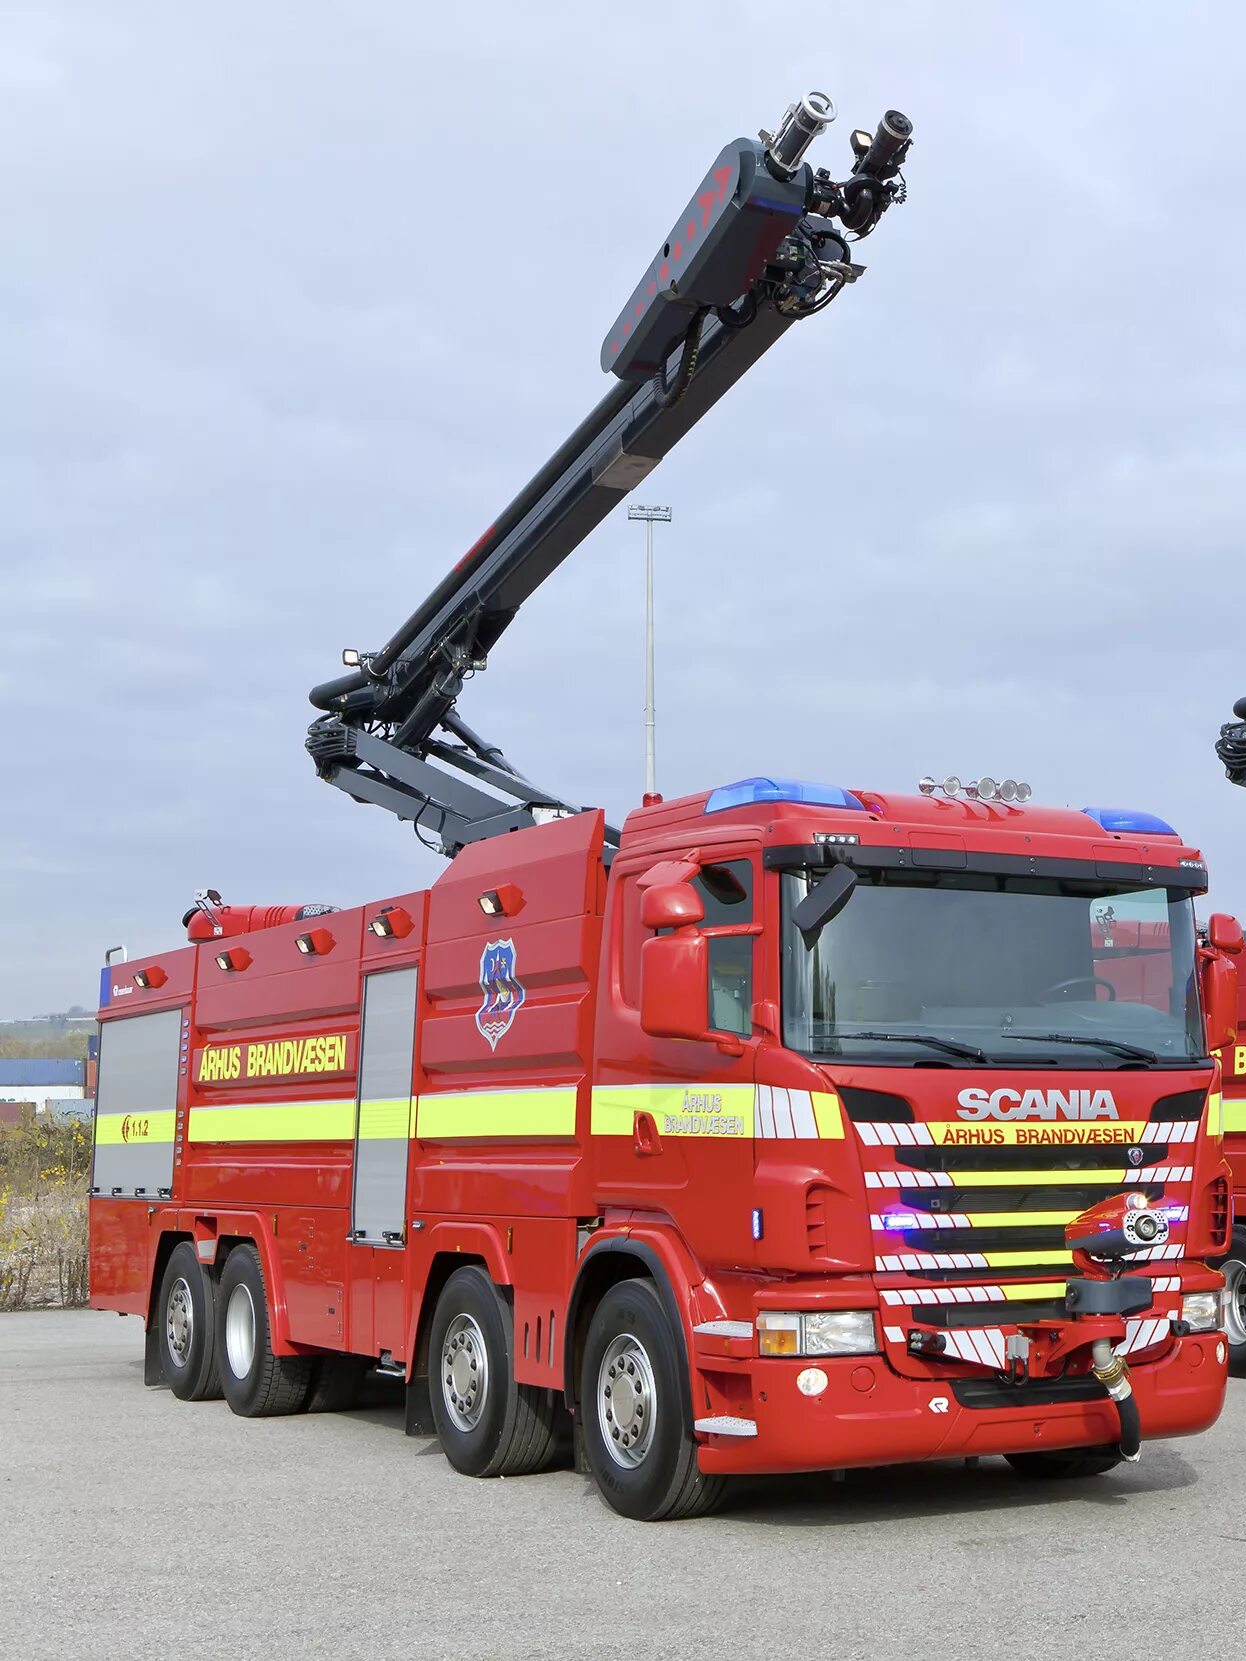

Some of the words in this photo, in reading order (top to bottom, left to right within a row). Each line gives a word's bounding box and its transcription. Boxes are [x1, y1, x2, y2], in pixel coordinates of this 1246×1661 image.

[247, 1035, 347, 1077] BRANDVÆSEN
[956, 1087, 1120, 1121] SCANIA
[664, 1115, 744, 1135] BRANDVÆSEN
[943, 1123, 1005, 1144] ÅRHUS
[1015, 1127, 1135, 1144] BRANDVÆSEN
